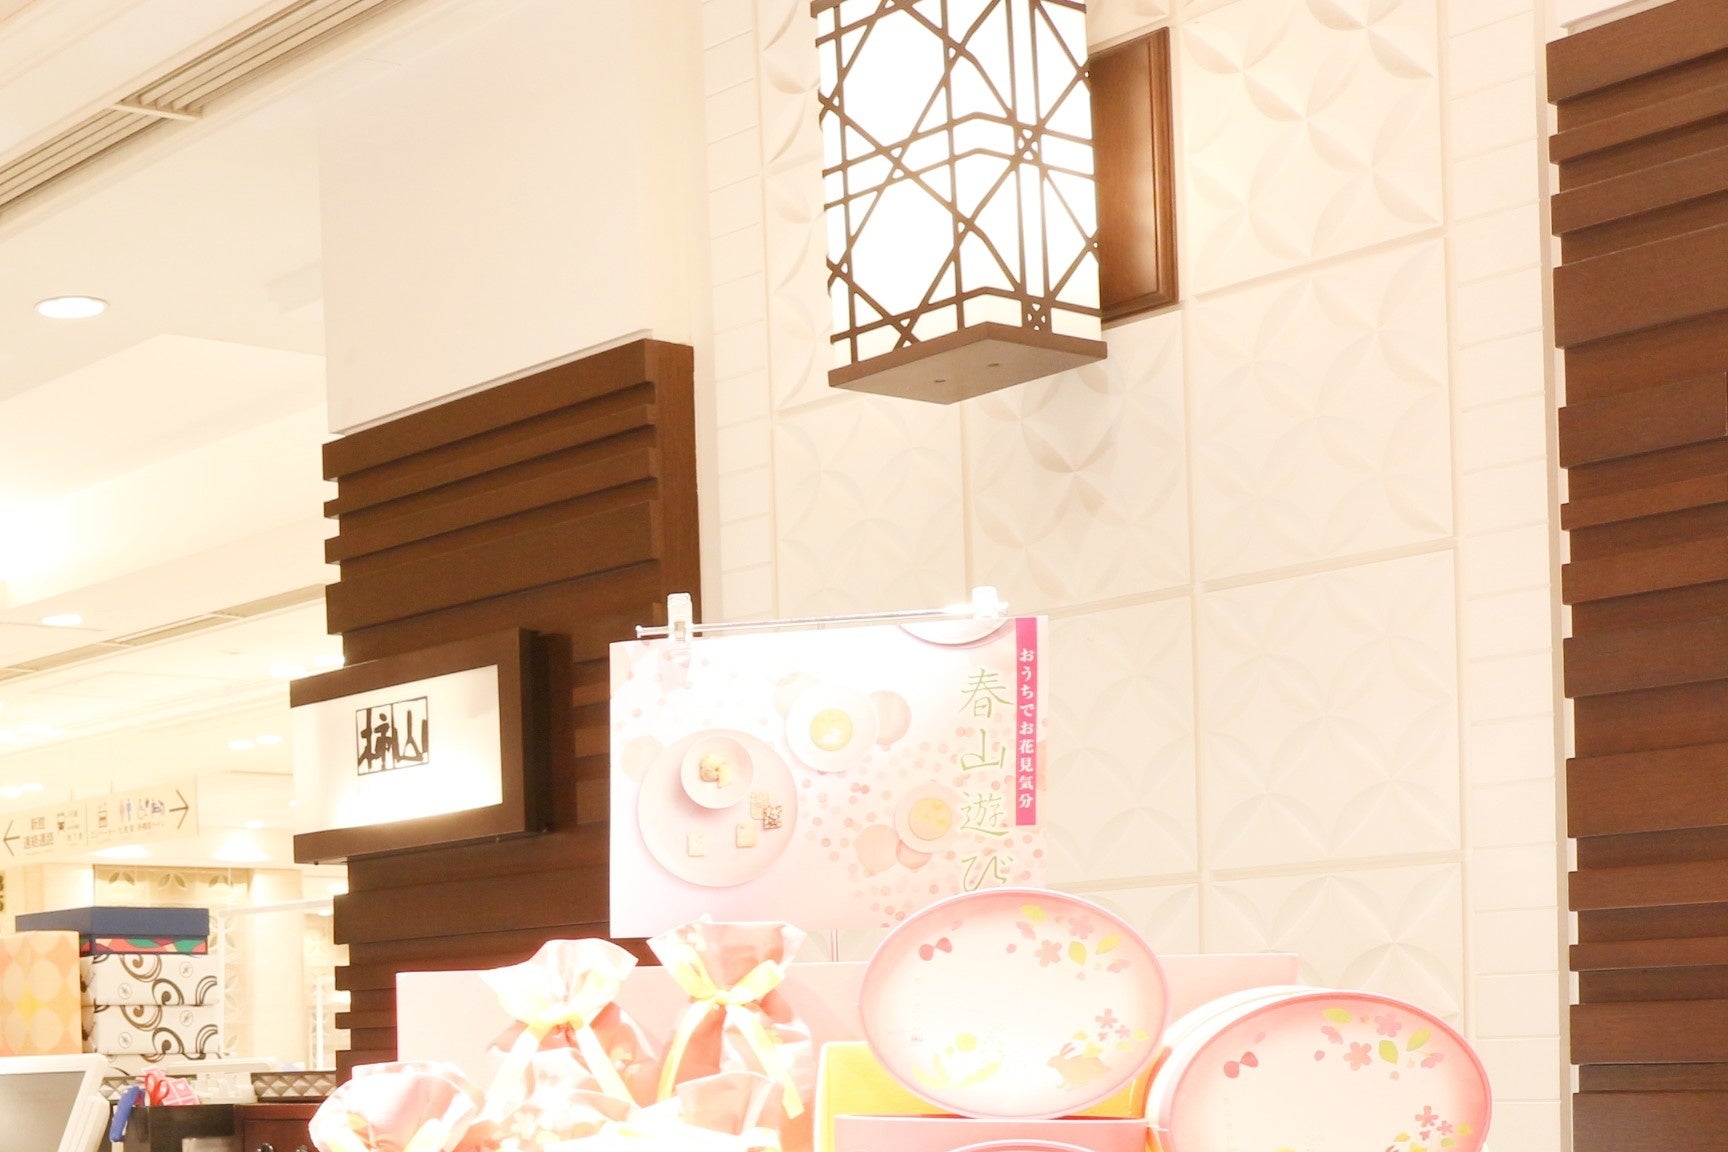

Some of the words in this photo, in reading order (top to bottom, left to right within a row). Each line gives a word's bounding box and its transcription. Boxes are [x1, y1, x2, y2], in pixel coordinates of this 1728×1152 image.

[356, 695, 430, 776] 柿山
[958, 666, 1015, 892] 春山遊び
[1018, 647, 1036, 810] おうちでお花見気分
